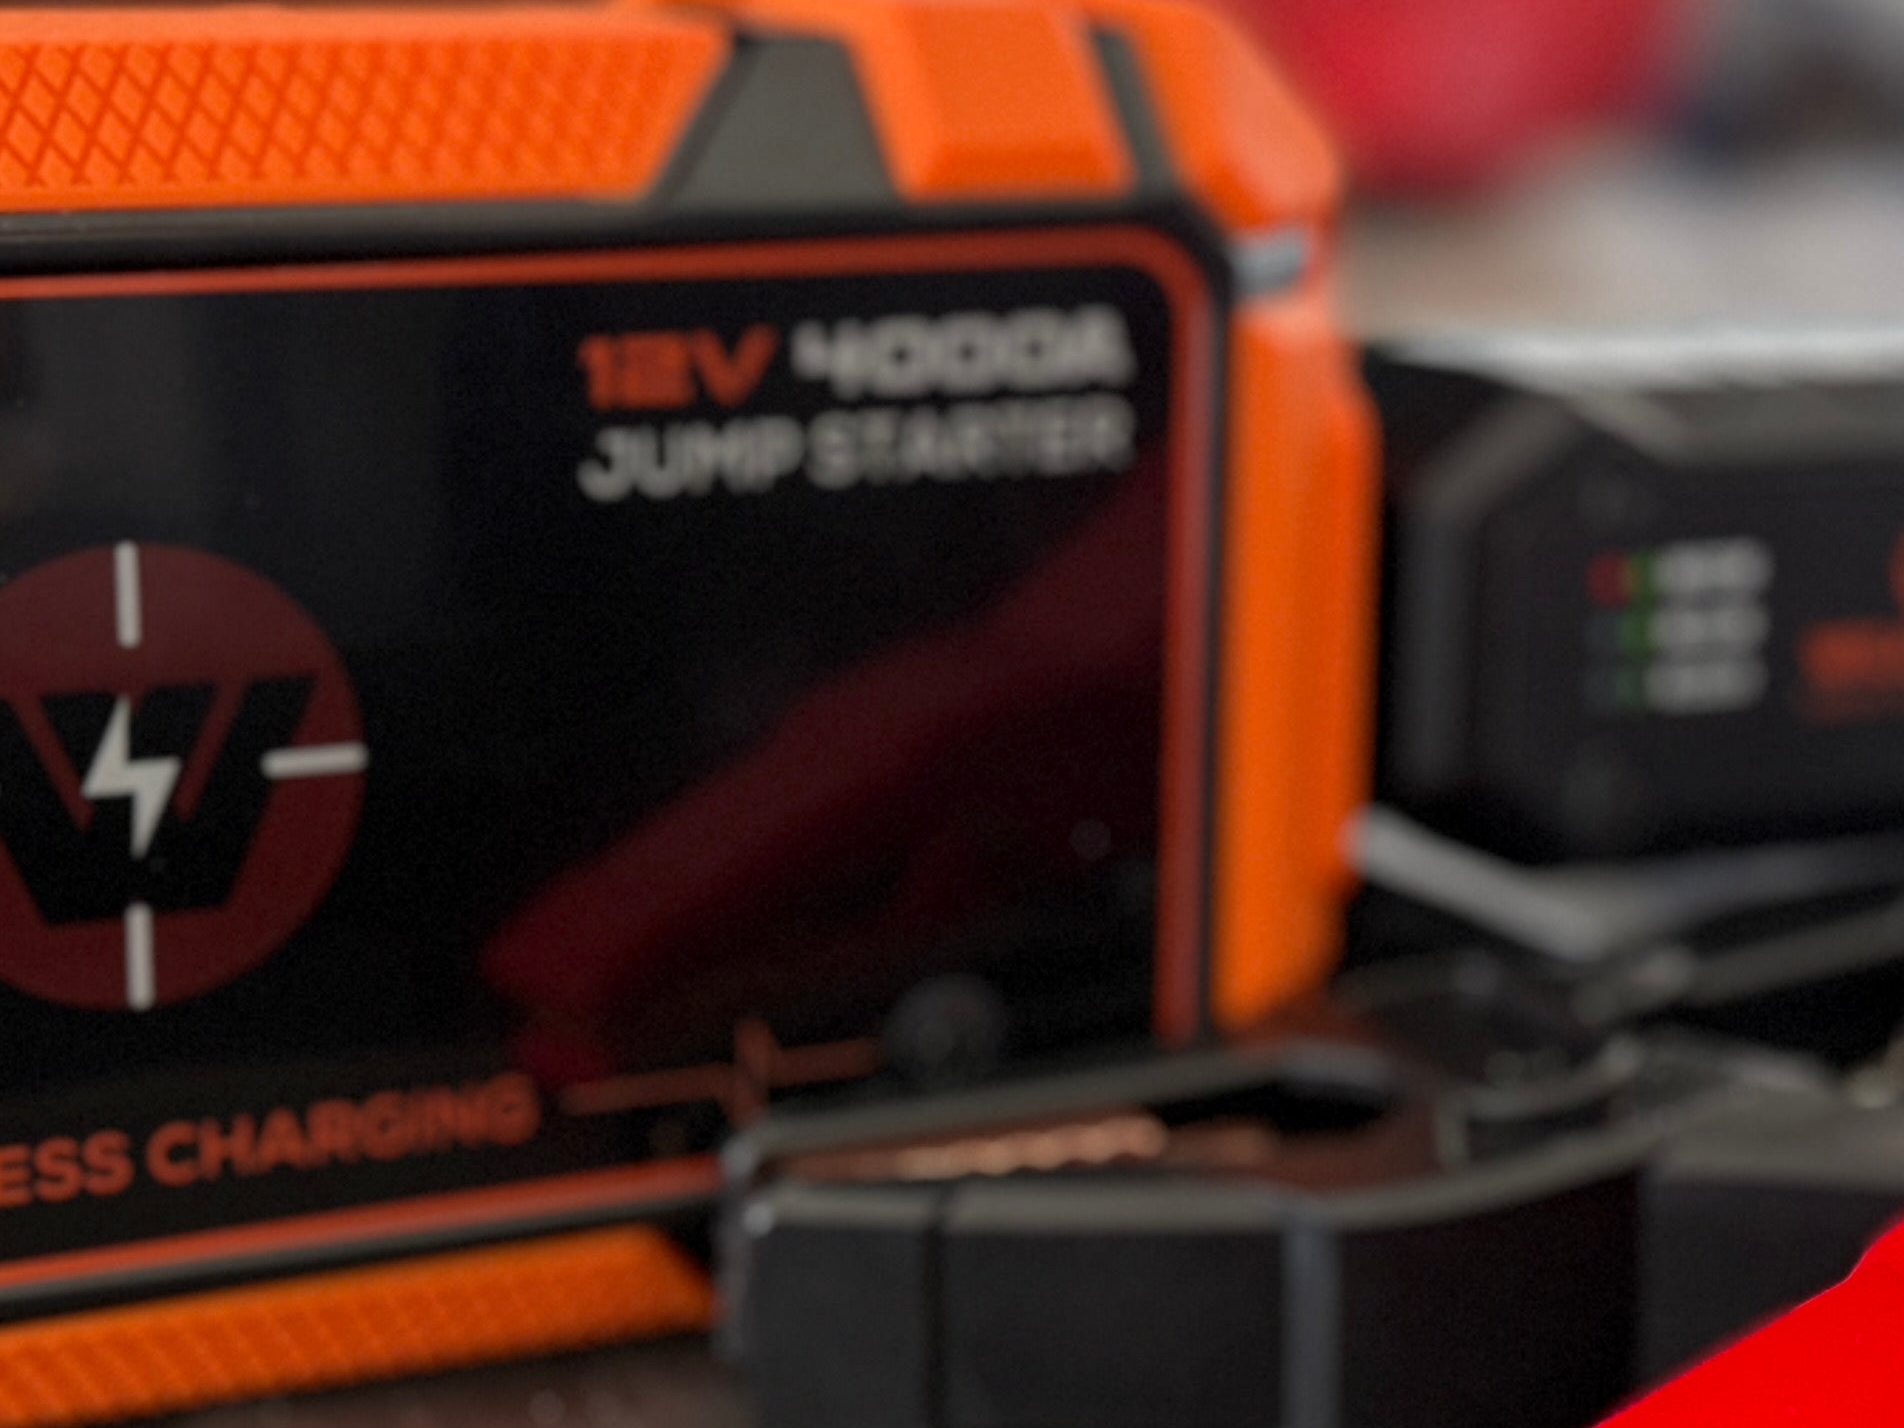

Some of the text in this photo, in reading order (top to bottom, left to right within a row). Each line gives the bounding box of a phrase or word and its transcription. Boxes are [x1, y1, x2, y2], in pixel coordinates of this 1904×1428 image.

[576, 304, 1135, 412] 12V 4000A
[577, 395, 1135, 502] JUMP STARTER
[144, 1072, 540, 1186] CHARGING
